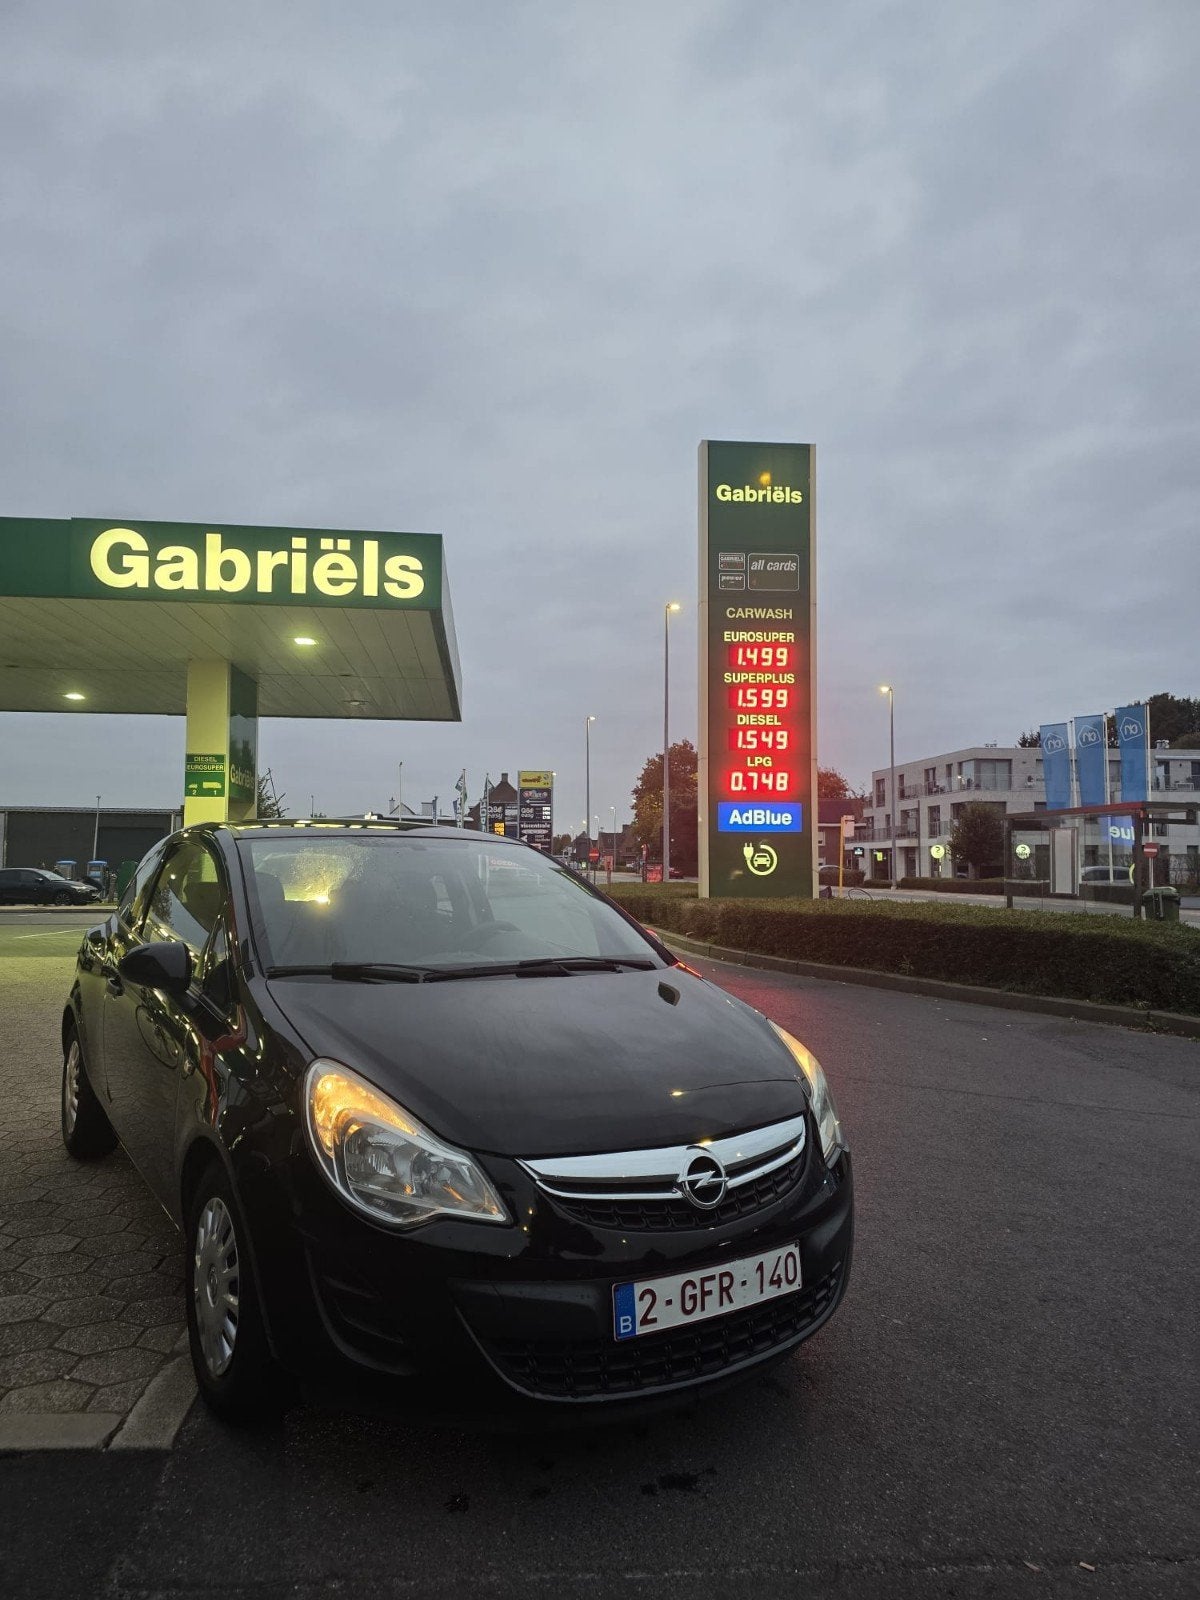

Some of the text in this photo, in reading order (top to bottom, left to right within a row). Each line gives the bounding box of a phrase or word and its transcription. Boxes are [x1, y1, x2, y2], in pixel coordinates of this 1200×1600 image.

[716, 485, 803, 504] Gabriëls
[90, 528, 425, 599] Gabriëls
[751, 559, 797, 571] all cards
[726, 607, 793, 619] CARWASH
[724, 631, 795, 643] EUROSUPER
[737, 647, 788, 667] 1.499
[724, 672, 795, 684] SUPERPLUS
[737, 688, 788, 708] 1.599
[737, 714, 781, 725] DIESEL
[737, 730, 788, 750] 1.549
[747, 756, 772, 767] LPG
[730, 772, 788, 792] 0.748
[728, 809, 793, 826] AdBlue
[639, 1251, 797, 1326] 2-GFR-140
[620, 1315, 633, 1333] B
